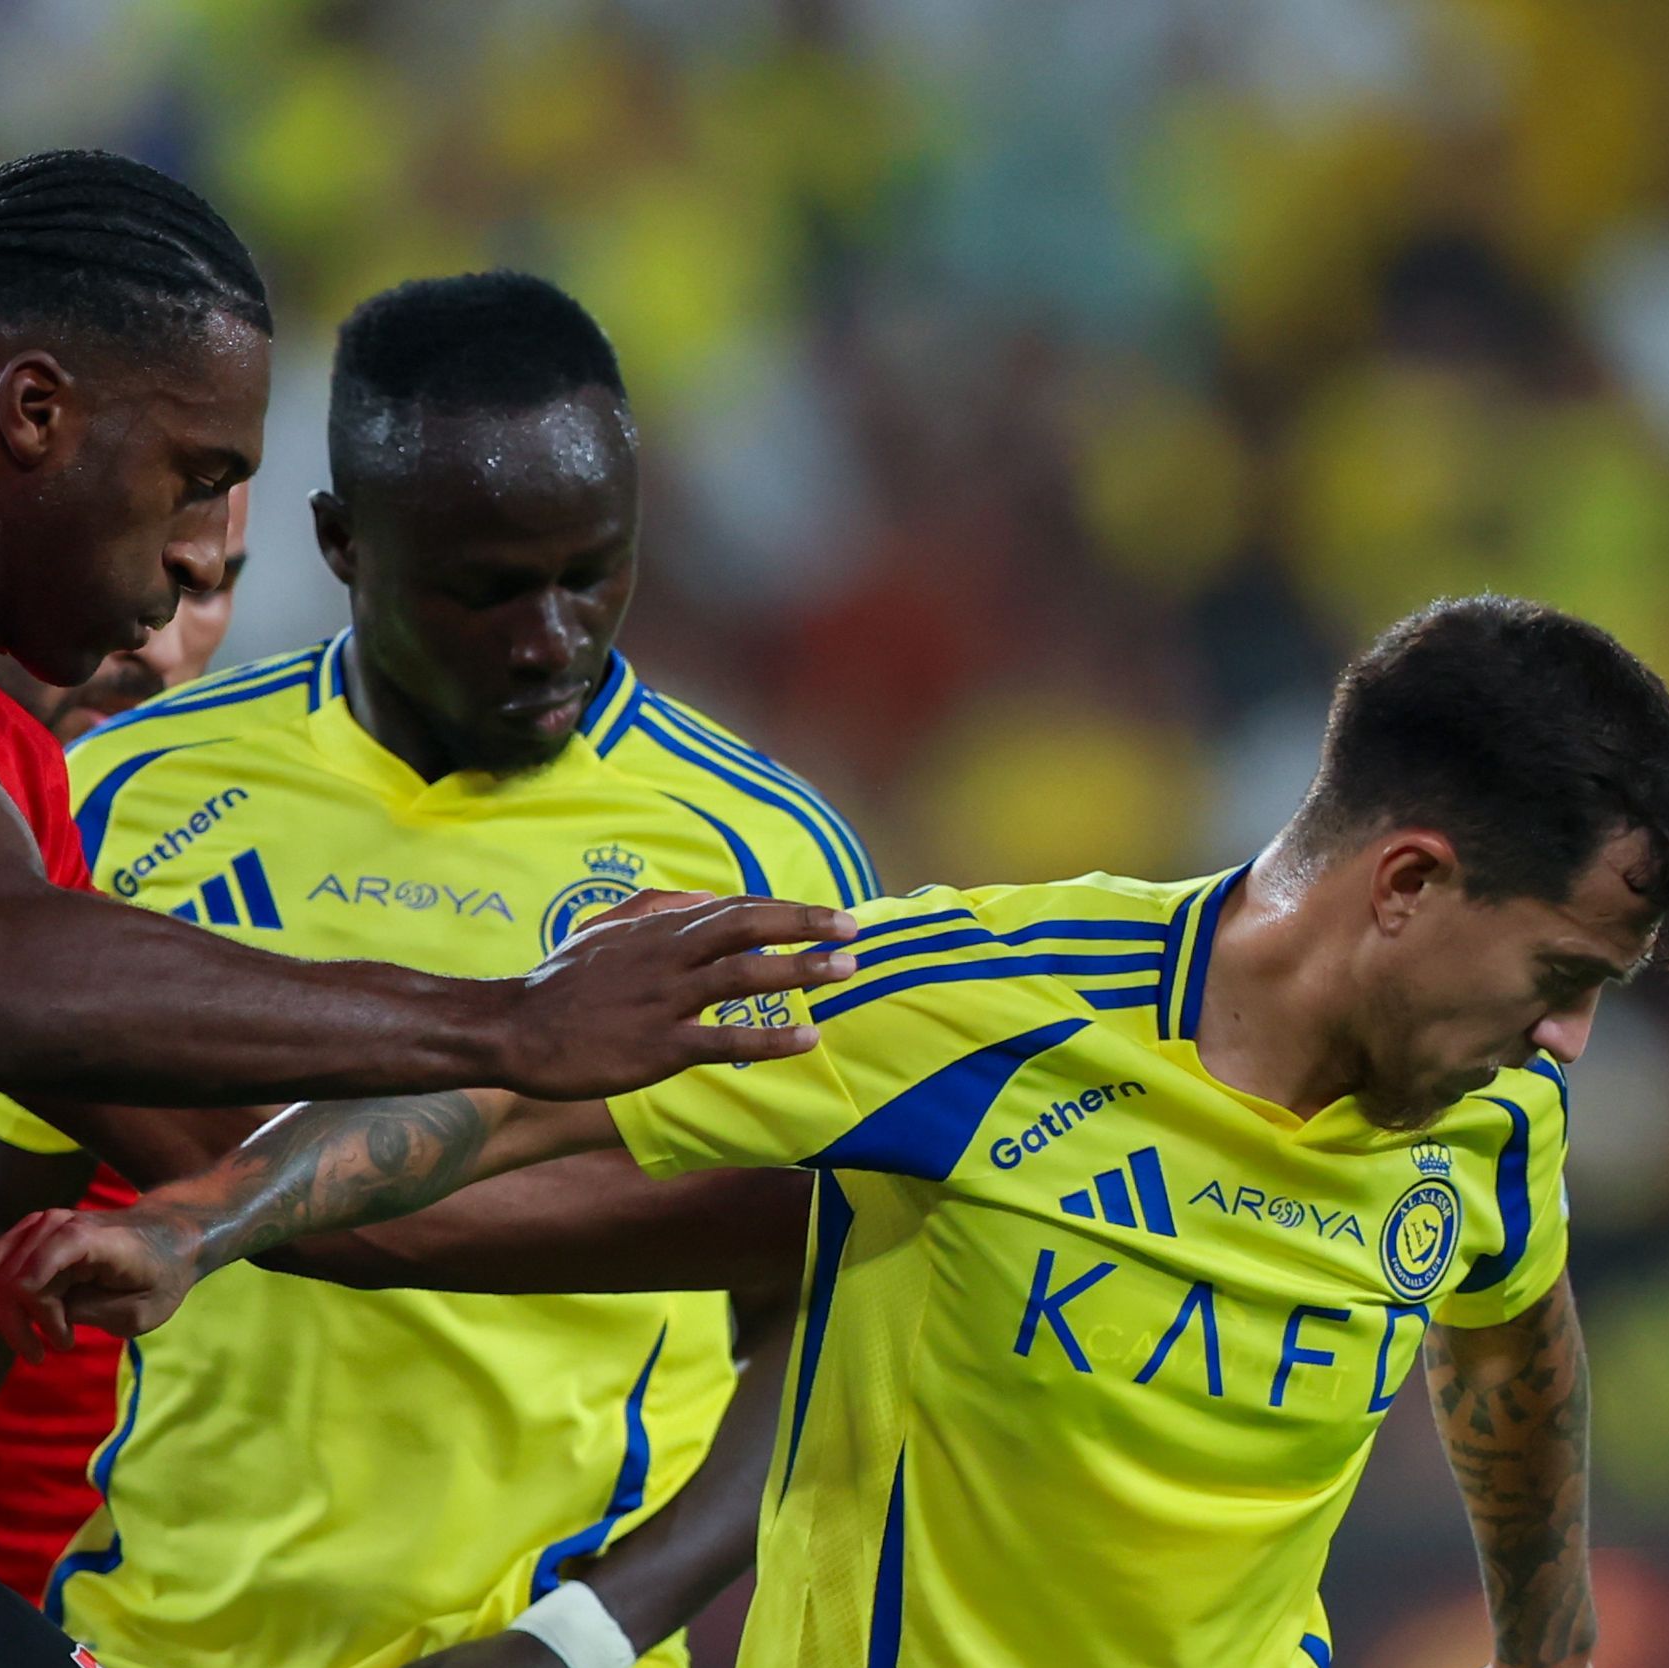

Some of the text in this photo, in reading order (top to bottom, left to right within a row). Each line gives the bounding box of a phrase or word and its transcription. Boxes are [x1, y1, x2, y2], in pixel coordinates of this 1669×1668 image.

[113, 787, 249, 898] Gathern
[307, 873, 514, 923] AROYA
[990, 1081, 1147, 1170] Gathern
[1188, 1180, 1365, 1246] AROYA
